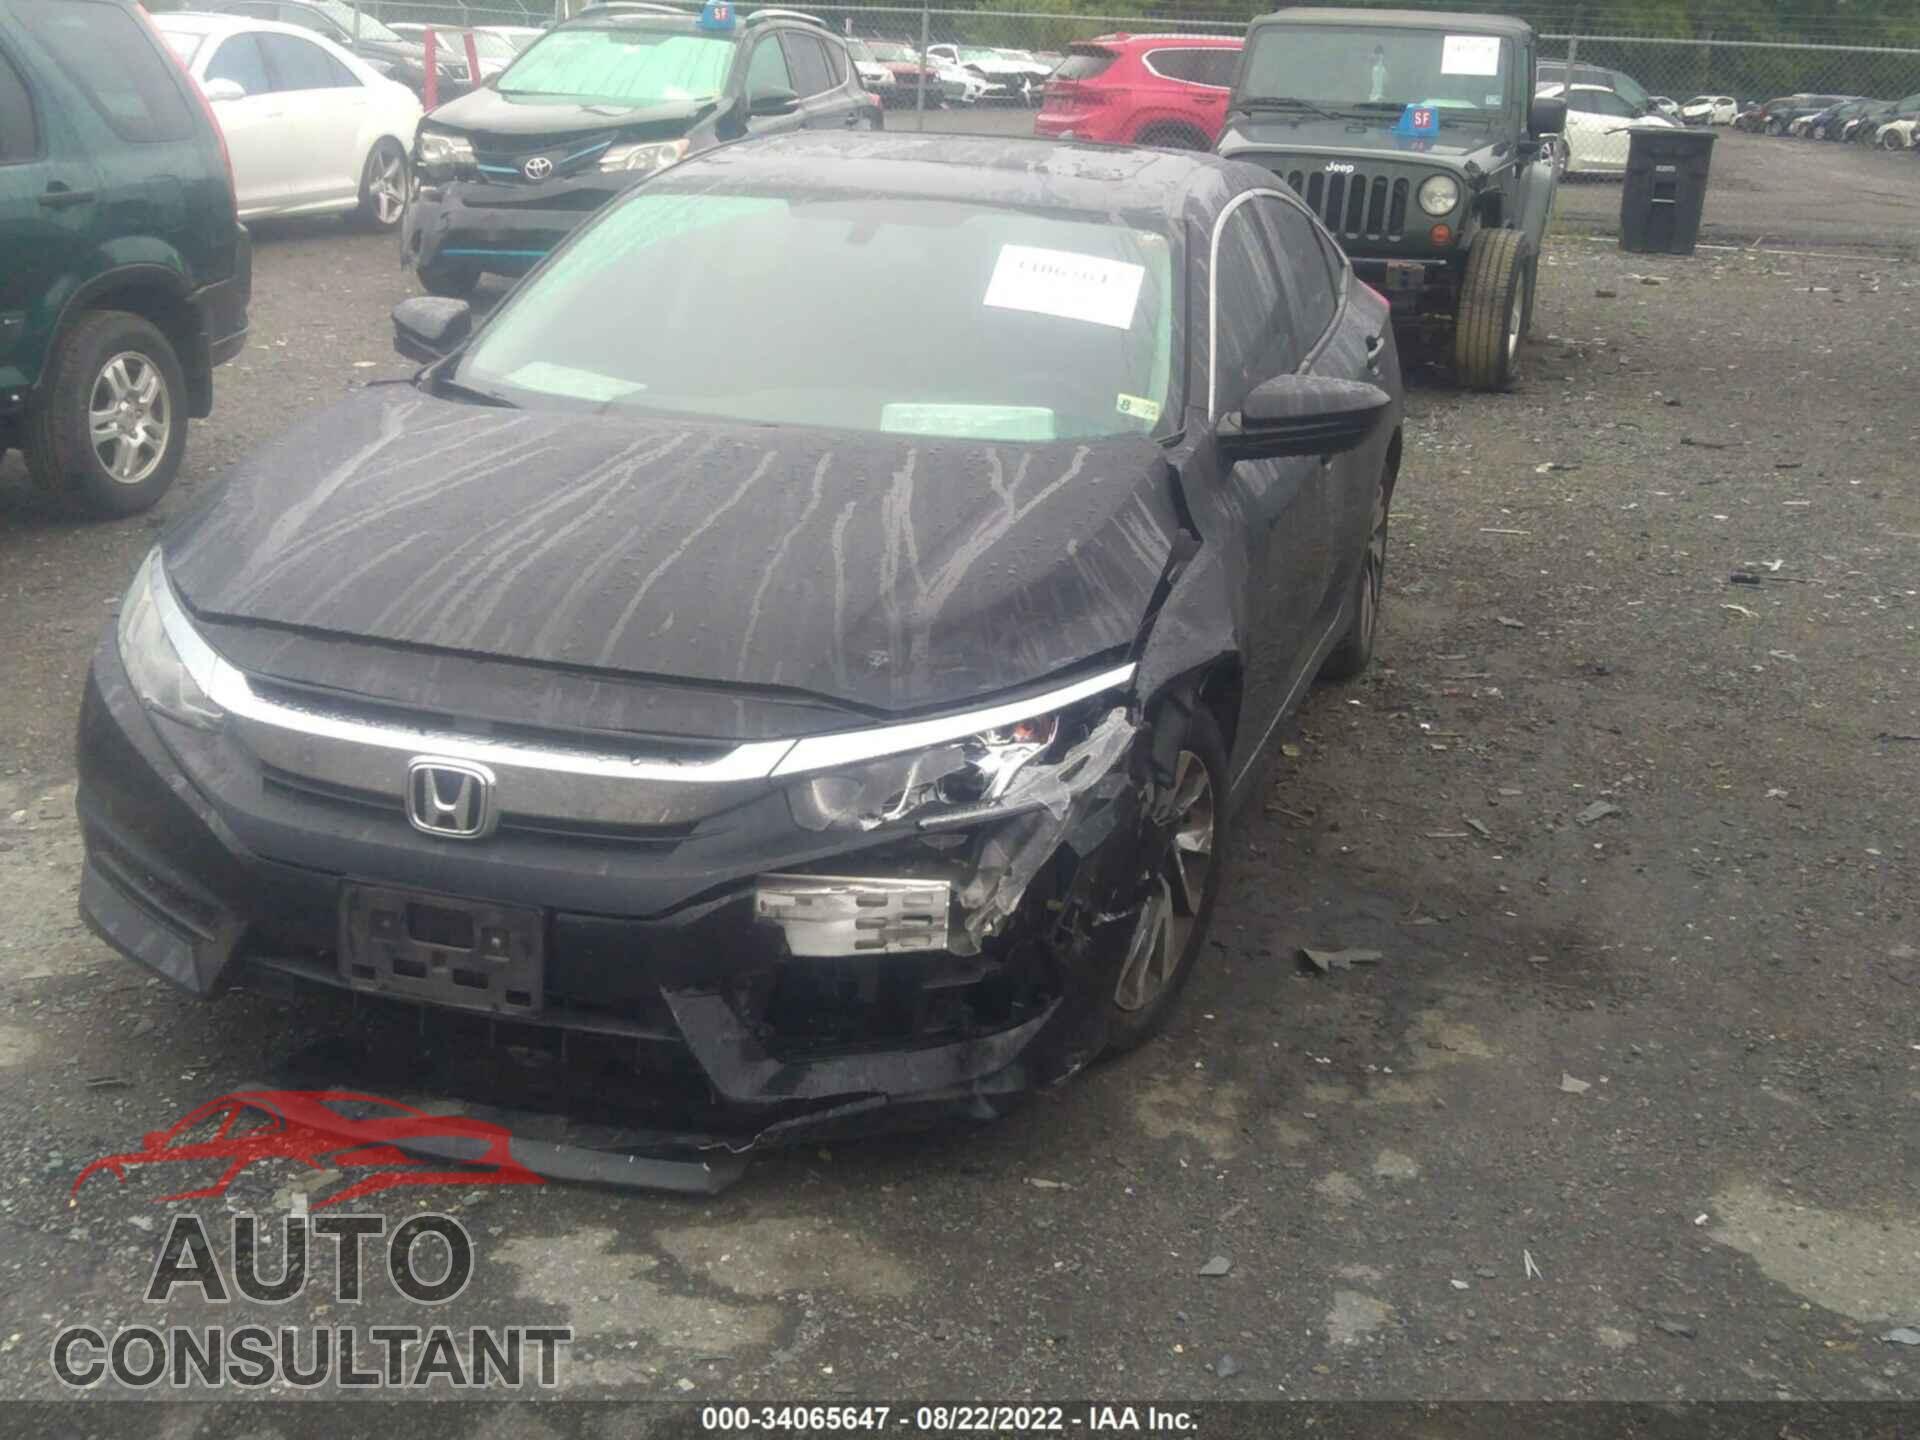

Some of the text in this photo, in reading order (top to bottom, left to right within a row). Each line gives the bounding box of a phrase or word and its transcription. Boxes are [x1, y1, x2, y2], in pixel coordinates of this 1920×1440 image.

[713, 7, 727, 20] SF
[1414, 111, 1431, 125] SF
[1325, 160, 1354, 174] Jeep
